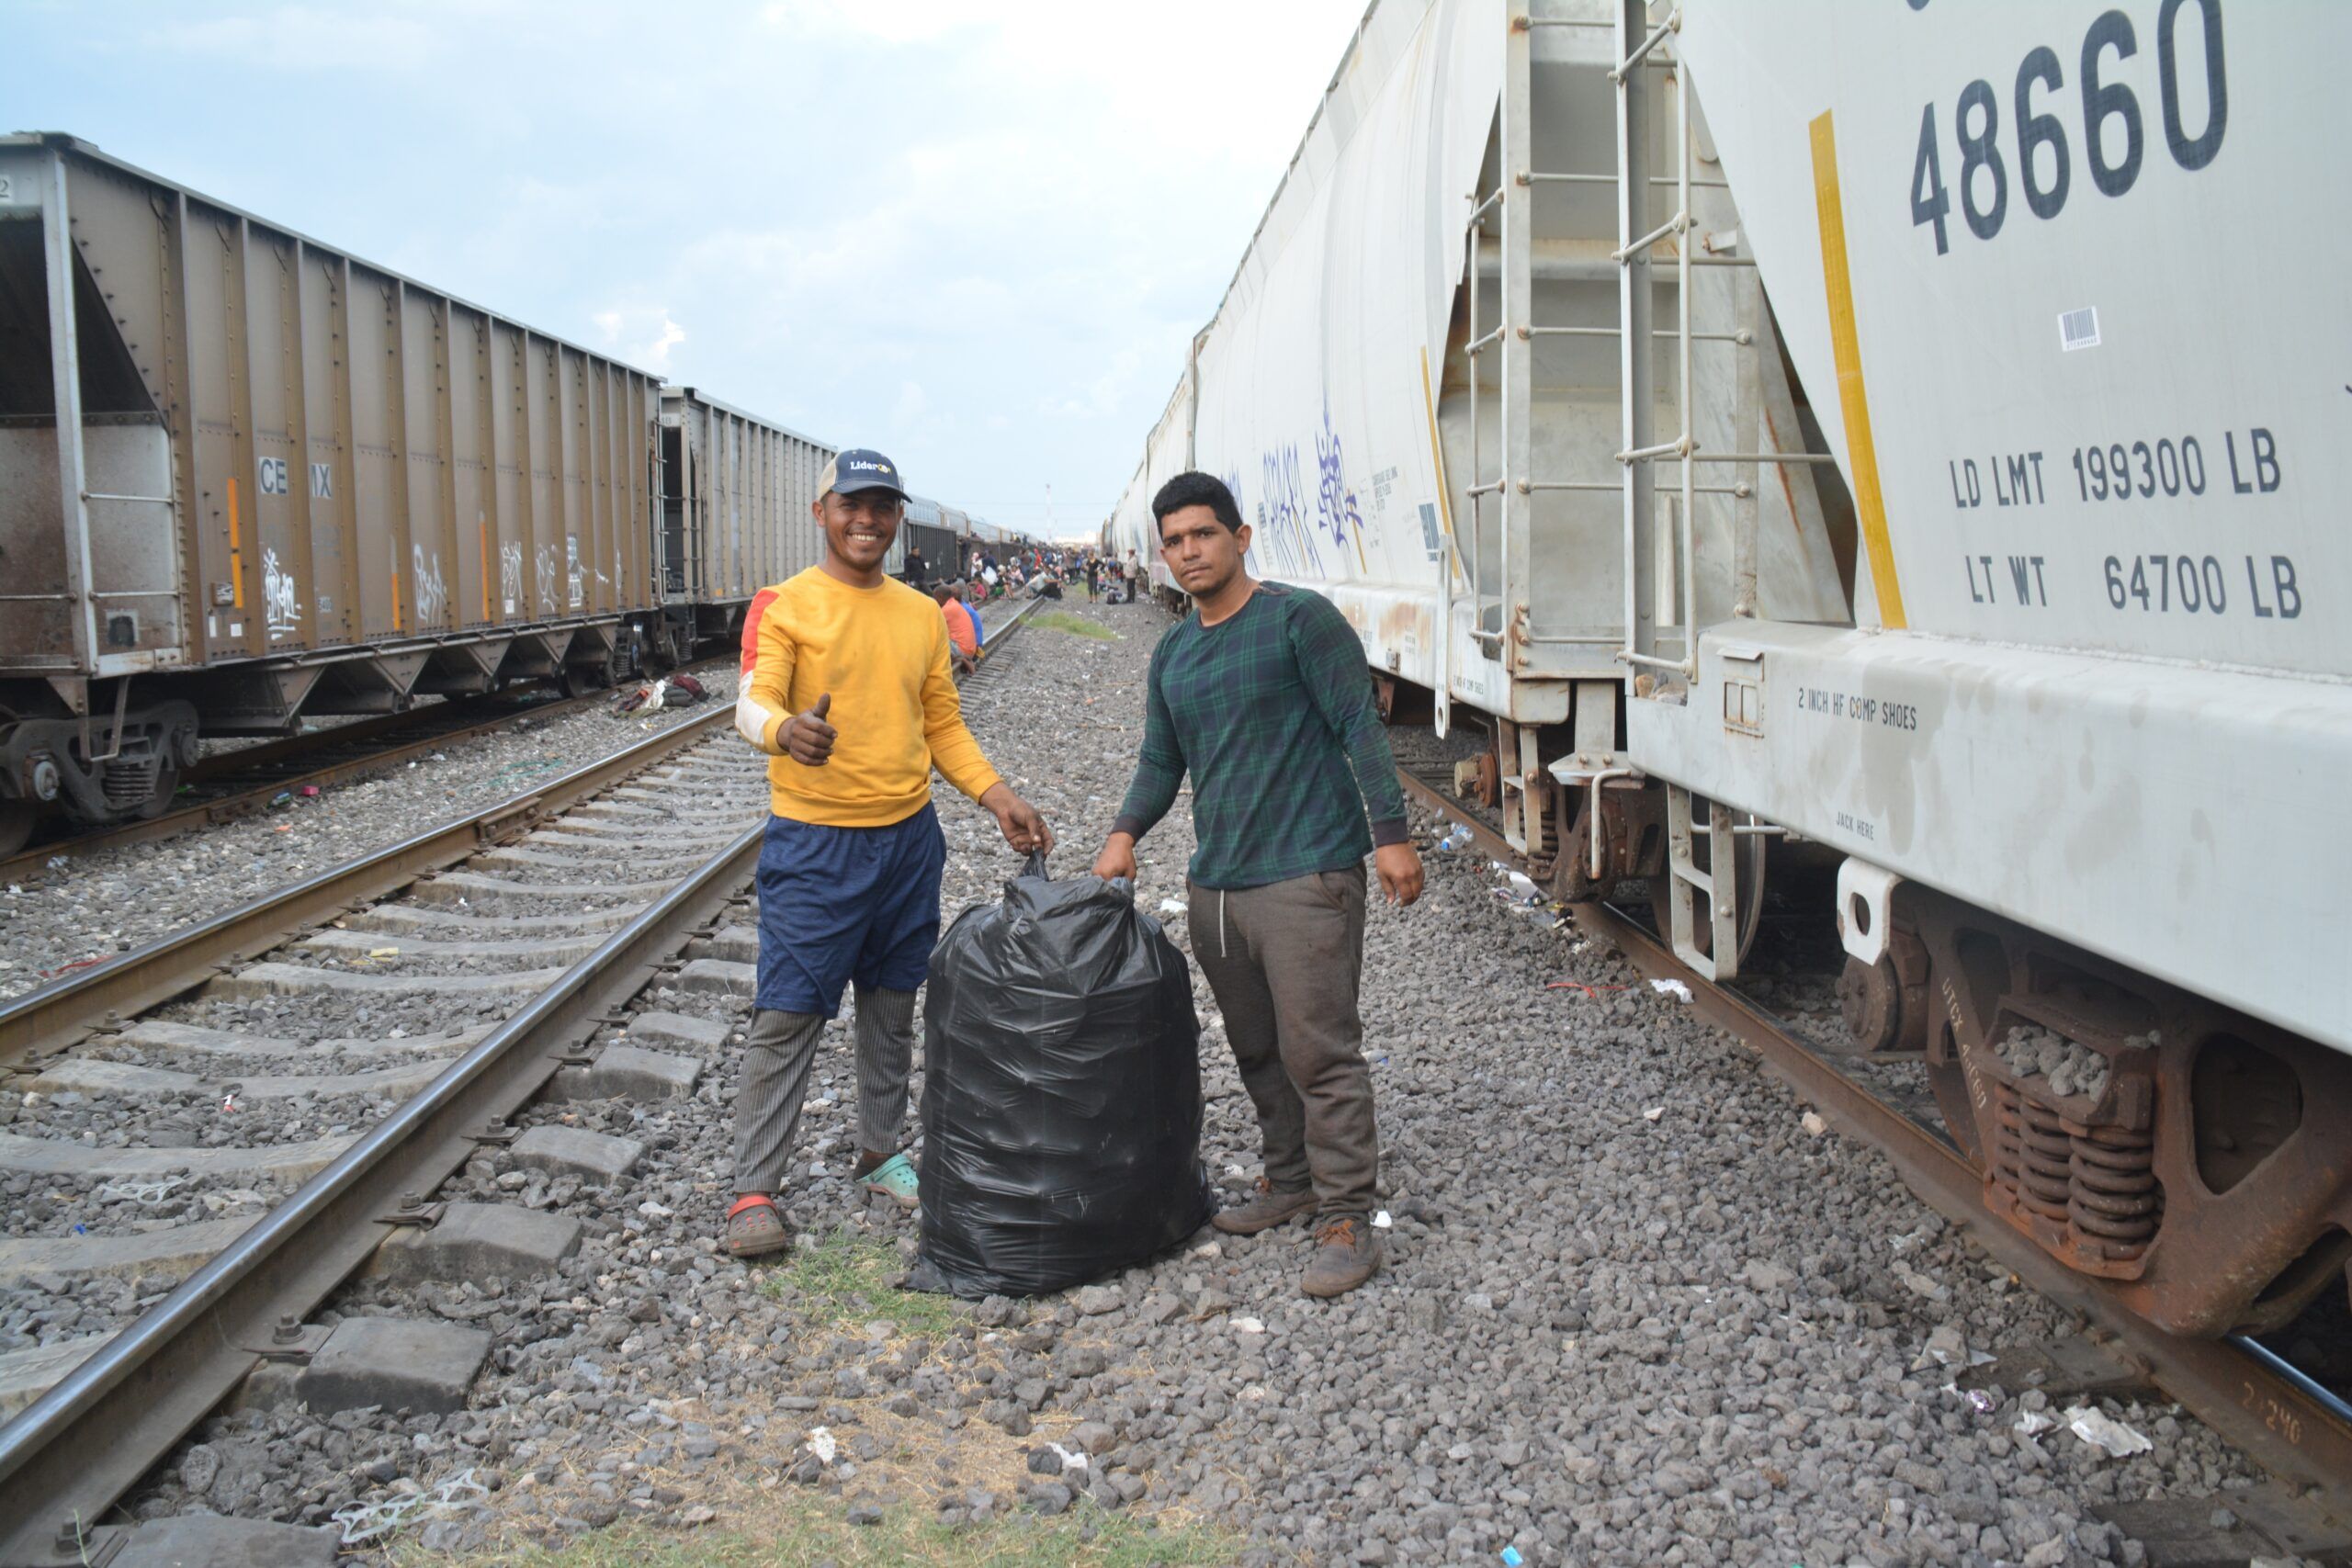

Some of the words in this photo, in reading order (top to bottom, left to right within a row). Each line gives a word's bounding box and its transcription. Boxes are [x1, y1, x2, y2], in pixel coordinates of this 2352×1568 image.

[1910, 0, 2228, 256] 48660
[1949, 457, 1982, 508] LD
[1991, 451, 2045, 507] LMT
[2072, 434, 2207, 502] 199300
[2224, 427, 2281, 494] LB
[1965, 555, 1996, 604] LT
[2007, 555, 2048, 607] WT
[2103, 554, 2227, 615] 64700
[2245, 554, 2302, 620] LB
[1798, 687, 1804, 709] 2
[1808, 688, 1828, 714] INCH
[1833, 692, 1844, 716] HF
[1849, 695, 1877, 723] COMP
[1883, 701, 1917, 731] SHOES
[1837, 811, 1853, 832] JACK
[1857, 819, 1874, 841] HERE
